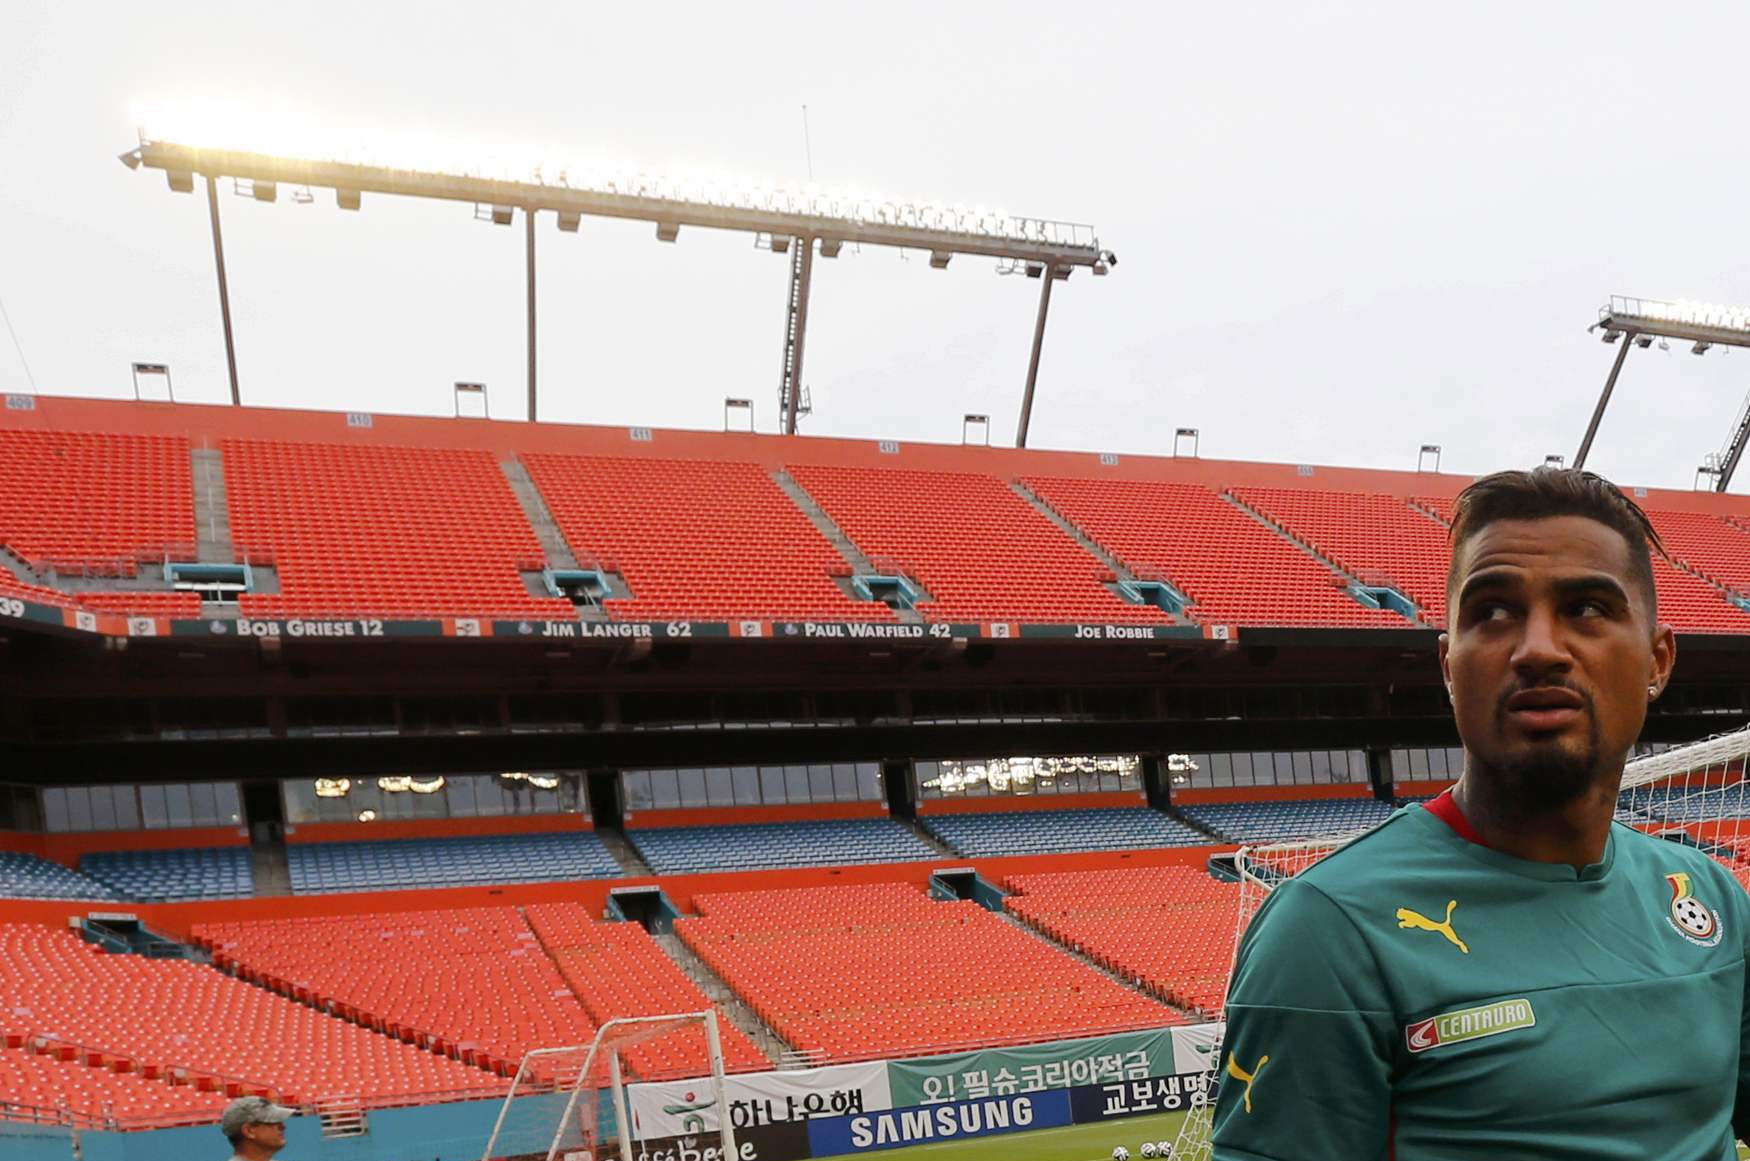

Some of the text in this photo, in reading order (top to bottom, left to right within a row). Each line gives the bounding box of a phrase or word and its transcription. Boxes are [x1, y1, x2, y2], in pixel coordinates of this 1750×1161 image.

[236, 619, 384, 636] BOB GRIESE 12
[542, 621, 692, 637] JIM LANGER 62
[804, 623, 951, 637] PAUL WARFIELD 42
[1075, 624, 1154, 639] JOE ROBBIE
[1440, 1001, 1527, 1038] CENTAURO
[920, 1075, 956, 1106] 오!
[1102, 1074, 1209, 1116] 교보생명
[850, 1097, 1034, 1147] SAMSUNG
